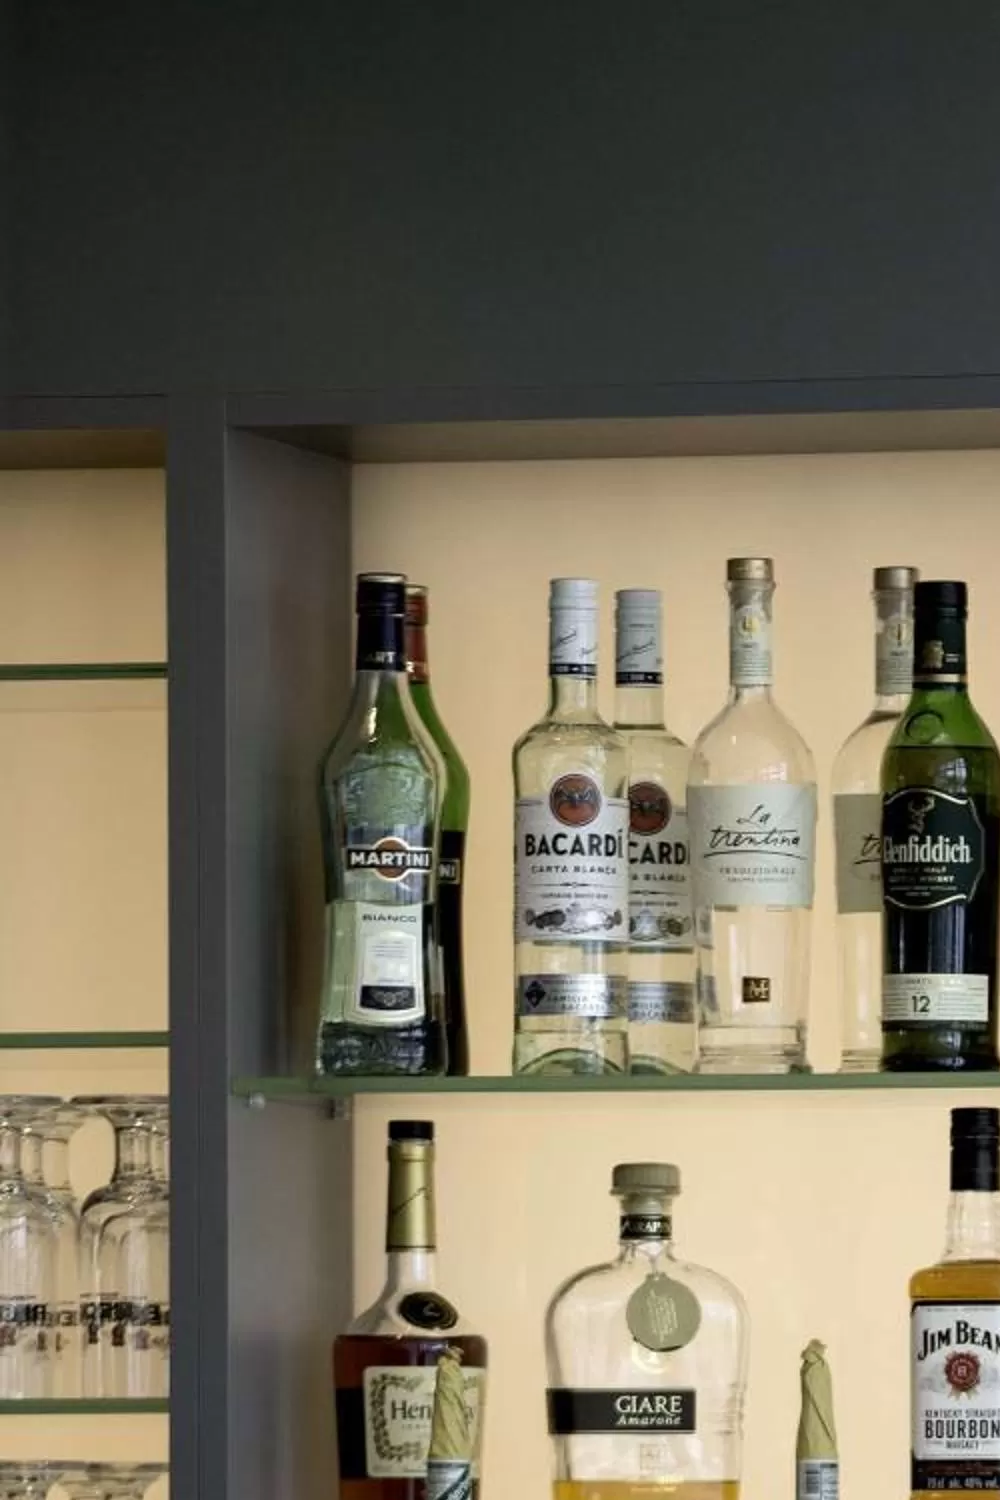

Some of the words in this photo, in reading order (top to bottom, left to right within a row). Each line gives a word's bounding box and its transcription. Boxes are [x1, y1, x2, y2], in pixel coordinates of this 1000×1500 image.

[736, 804, 771, 825] La
[709, 825, 800, 848] trentina
[351, 851, 429, 867] MARTINI
[362, 913, 417, 923] BIANCO
[911, 995, 931, 1013] 12
[917, 1327, 951, 1361] JIM
[615, 1395, 683, 1416] GIARE
[925, 1408, 962, 1418] KENTUCKY
[616, 1415, 681, 1426] Amarone
[924, 1419, 1000, 1438] BOURBON
